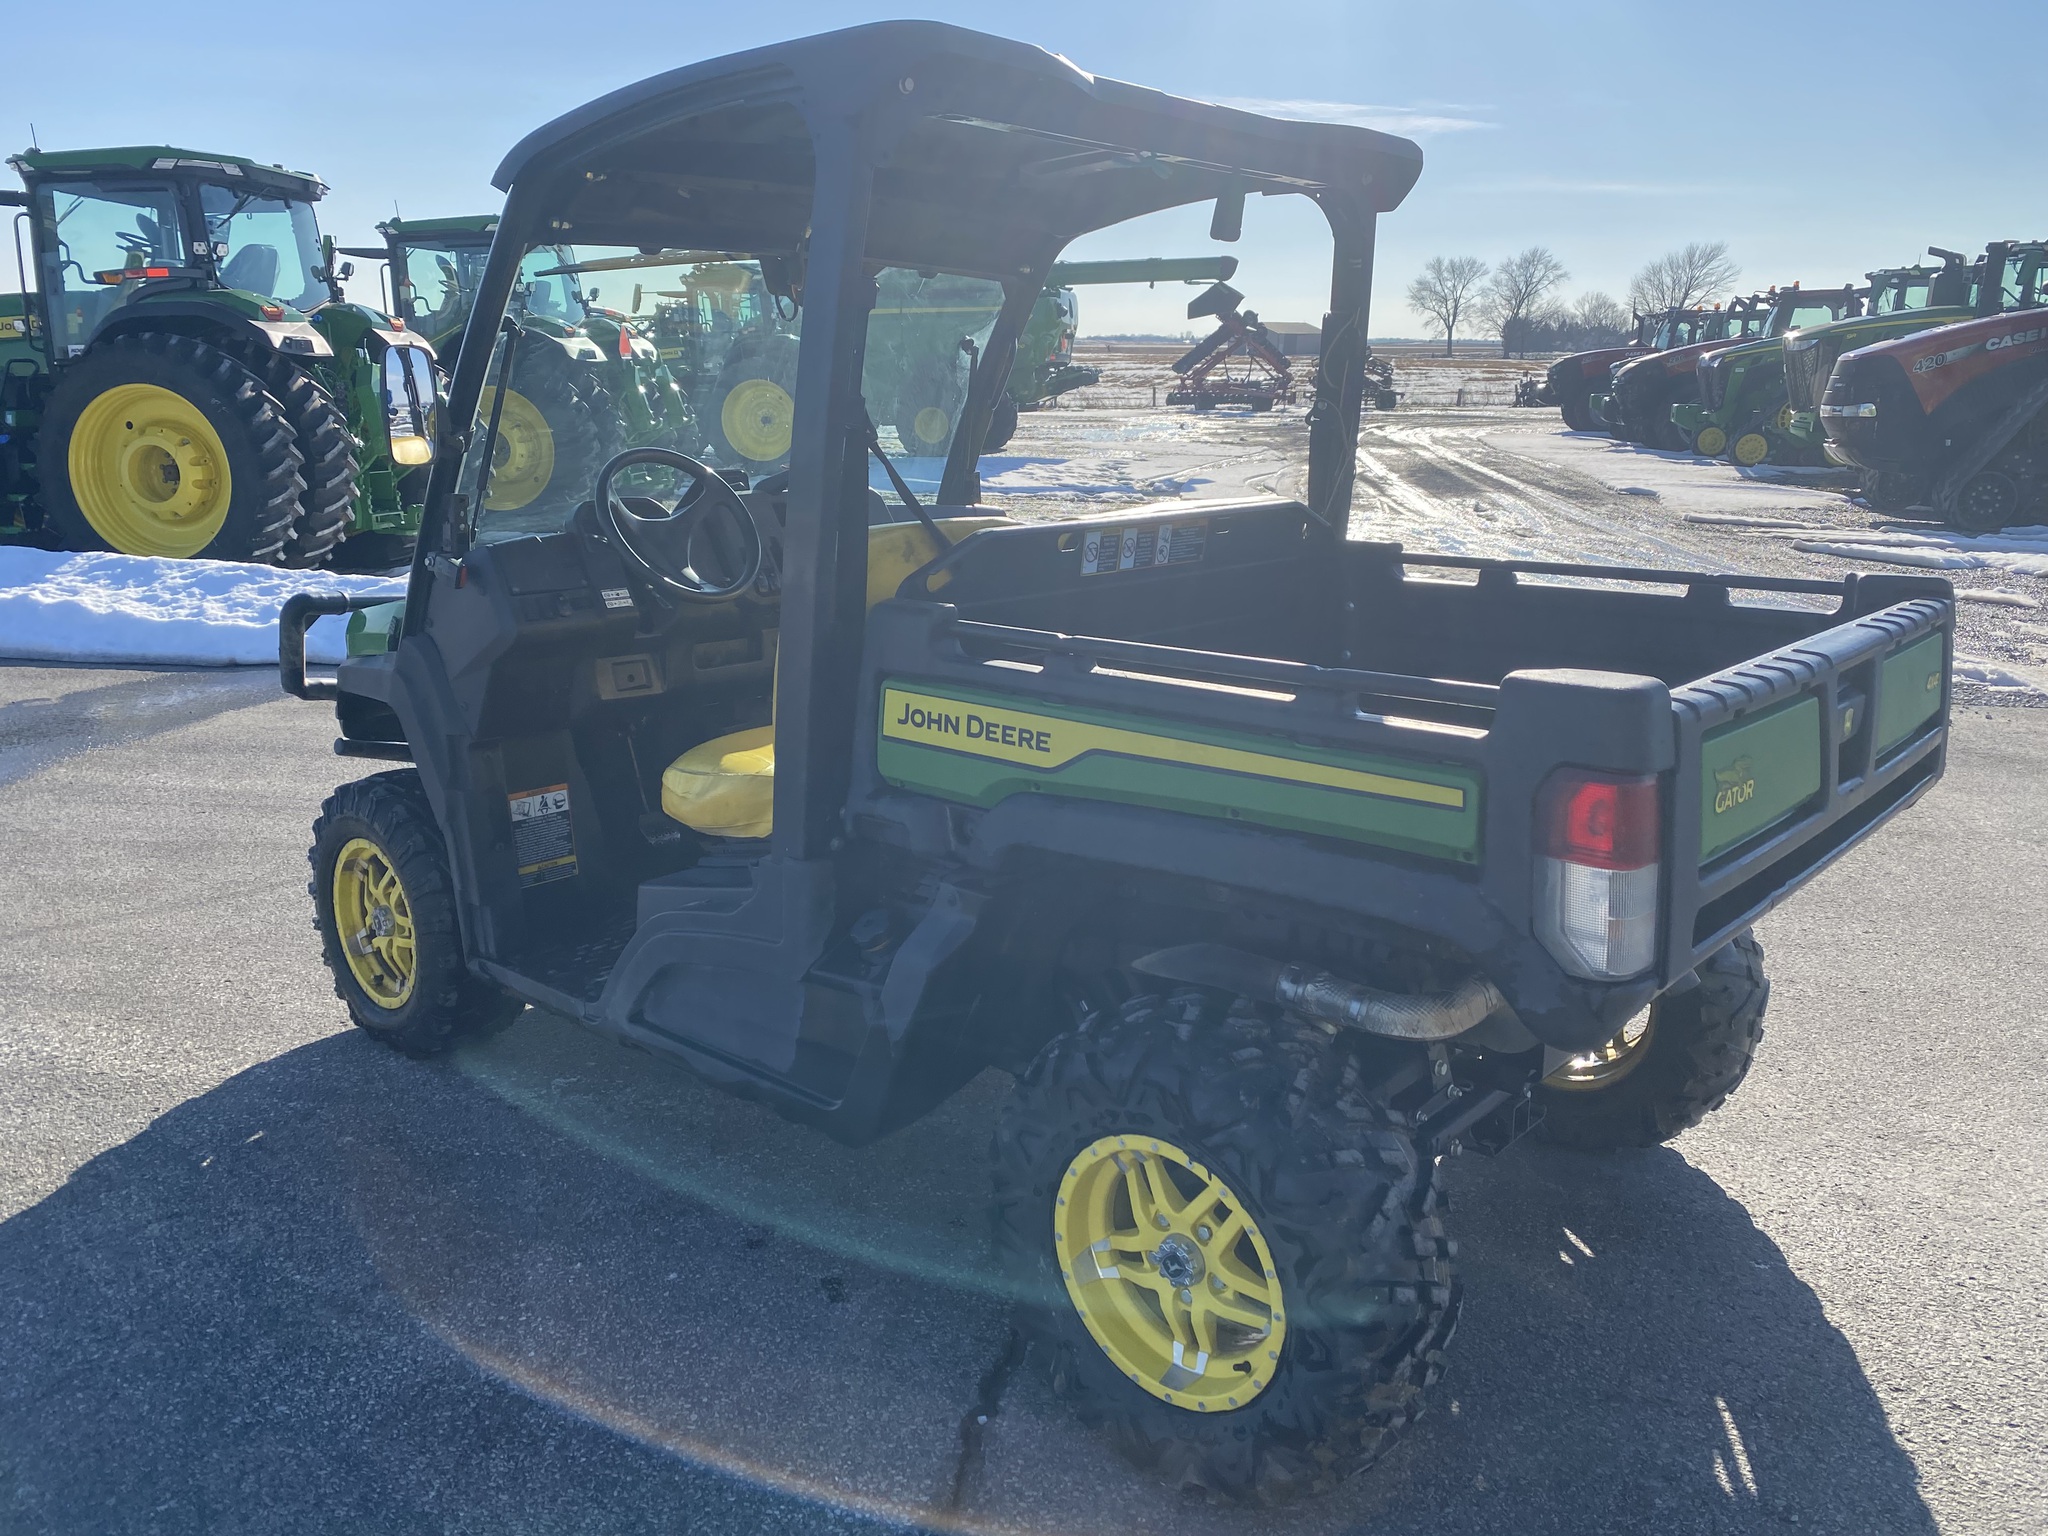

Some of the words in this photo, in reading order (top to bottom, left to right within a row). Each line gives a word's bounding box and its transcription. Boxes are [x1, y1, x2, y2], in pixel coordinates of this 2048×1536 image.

[1986, 329, 2039, 351] CASE
[1913, 352, 1948, 373] 420
[897, 703, 960, 735] JOHN
[966, 714, 1052, 753] DEERE
[1715, 779, 1755, 814] GATOR
